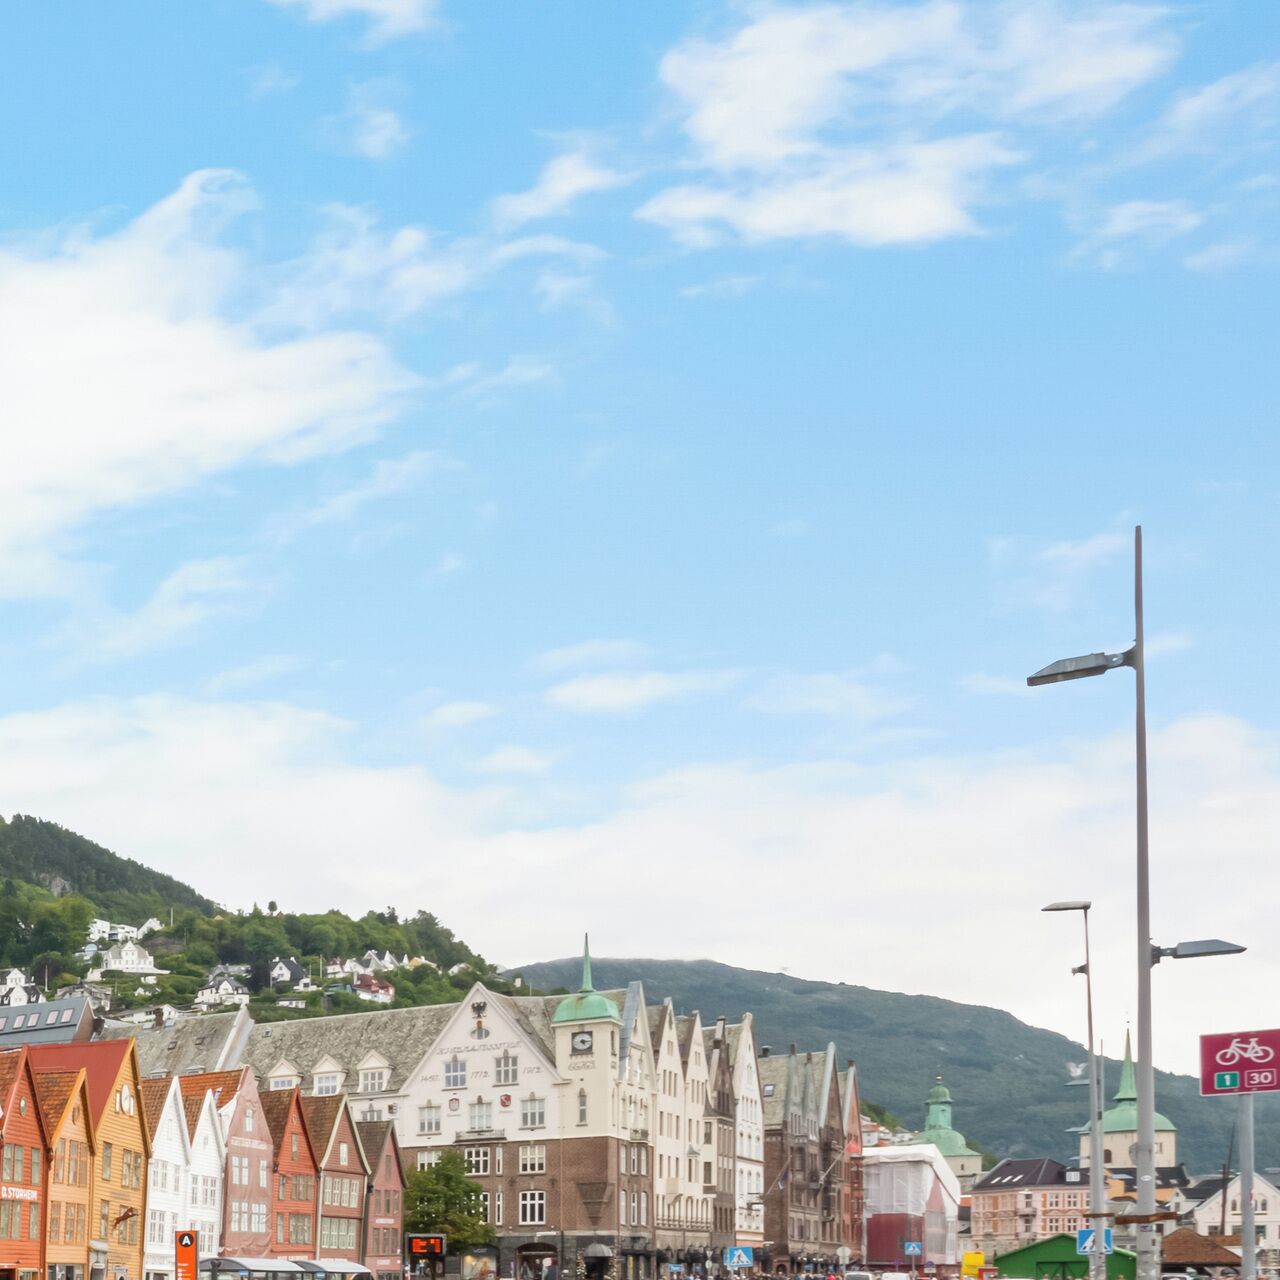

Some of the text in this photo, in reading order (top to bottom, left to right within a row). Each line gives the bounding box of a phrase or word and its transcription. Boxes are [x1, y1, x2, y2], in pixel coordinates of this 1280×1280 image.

[1224, 1072, 1272, 1086] 1 30
[182, 1235, 191, 1246] A
